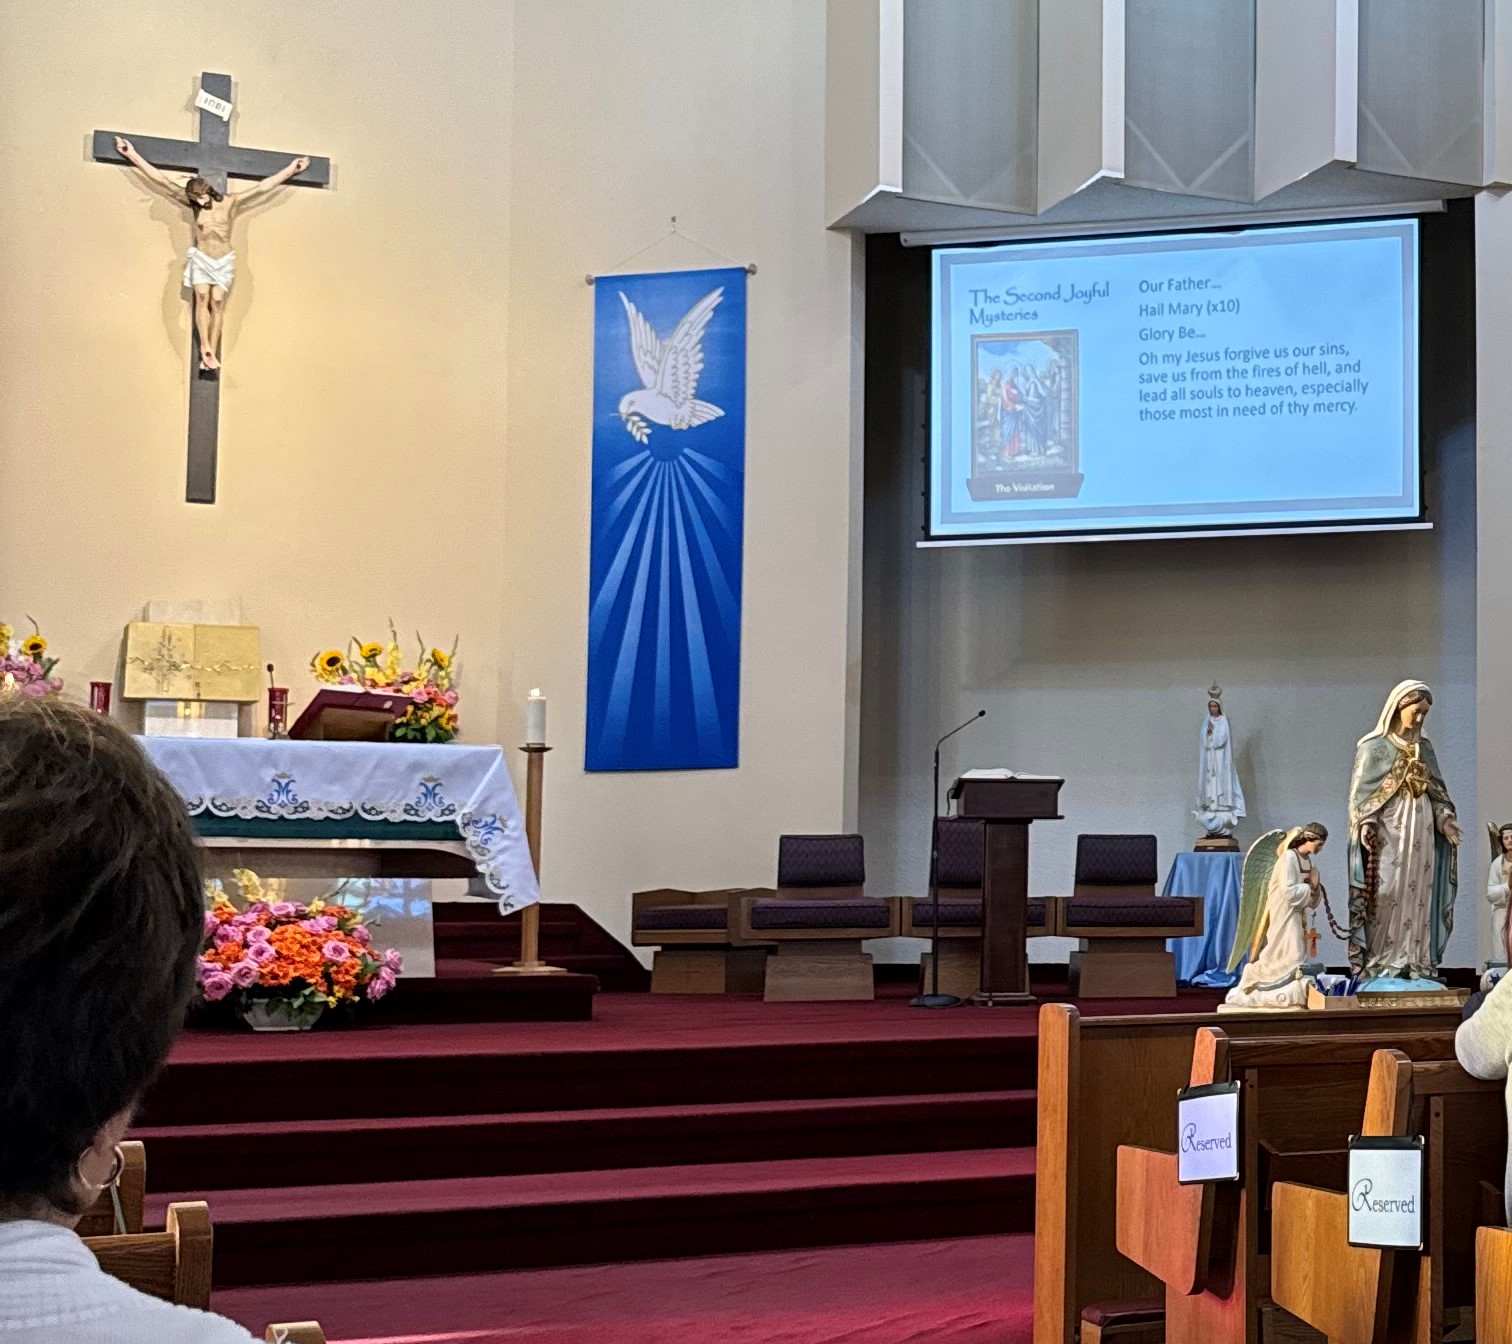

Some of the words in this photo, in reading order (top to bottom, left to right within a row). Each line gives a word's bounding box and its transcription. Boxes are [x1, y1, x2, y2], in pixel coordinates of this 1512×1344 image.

[969, 289, 1000, 306] The
[1003, 284, 1060, 305] Second
[1063, 281, 1110, 304] Joyful
[1139, 280, 1164, 293] Our
[969, 308, 1038, 327] Mysteries
[1139, 303, 1164, 316] Hail
[1168, 302, 1203, 316] Mary
[1206, 298, 1240, 316] (x10)
[1139, 327, 1175, 342] Glory
[1139, 352, 1158, 365] Oh
[1162, 353, 1182, 366] my
[1185, 350, 1220, 363] Jesus
[1224, 347, 1270, 363] forgive
[1274, 347, 1289, 358] us
[1292, 345, 1315, 357] our
[1319, 342, 1349, 356] sins,
[1139, 372, 1168, 384] save
[1172, 371, 1187, 382] us
[1191, 368, 1222, 381] from
[1226, 366, 1248, 379] the
[1252, 364, 1281, 377] fires
[1285, 362, 1299, 376] of
[1302, 361, 1331, 376] hell,
[1335, 359, 1361, 373] and
[1139, 388, 1167, 402] lead
[1170, 387, 1186, 401] all
[1190, 385, 1223, 400] souls
[1227, 386, 1241, 398] to
[1245, 384, 1298, 397] heaven,
[1301, 378, 1369, 397] especially
[1139, 408, 1176, 421] those
[1180, 406, 1213, 419] most
[1216, 404, 1229, 418] in
[1232, 402, 1266, 417] need
[1270, 400, 1284, 415] of
[1287, 400, 1309, 416] thy
[1313, 401, 1358, 415] mercy.
[994, 483, 1011, 493] The
[1181, 1122, 1232, 1153] Reserved
[1352, 1178, 1415, 1213] Reserved
